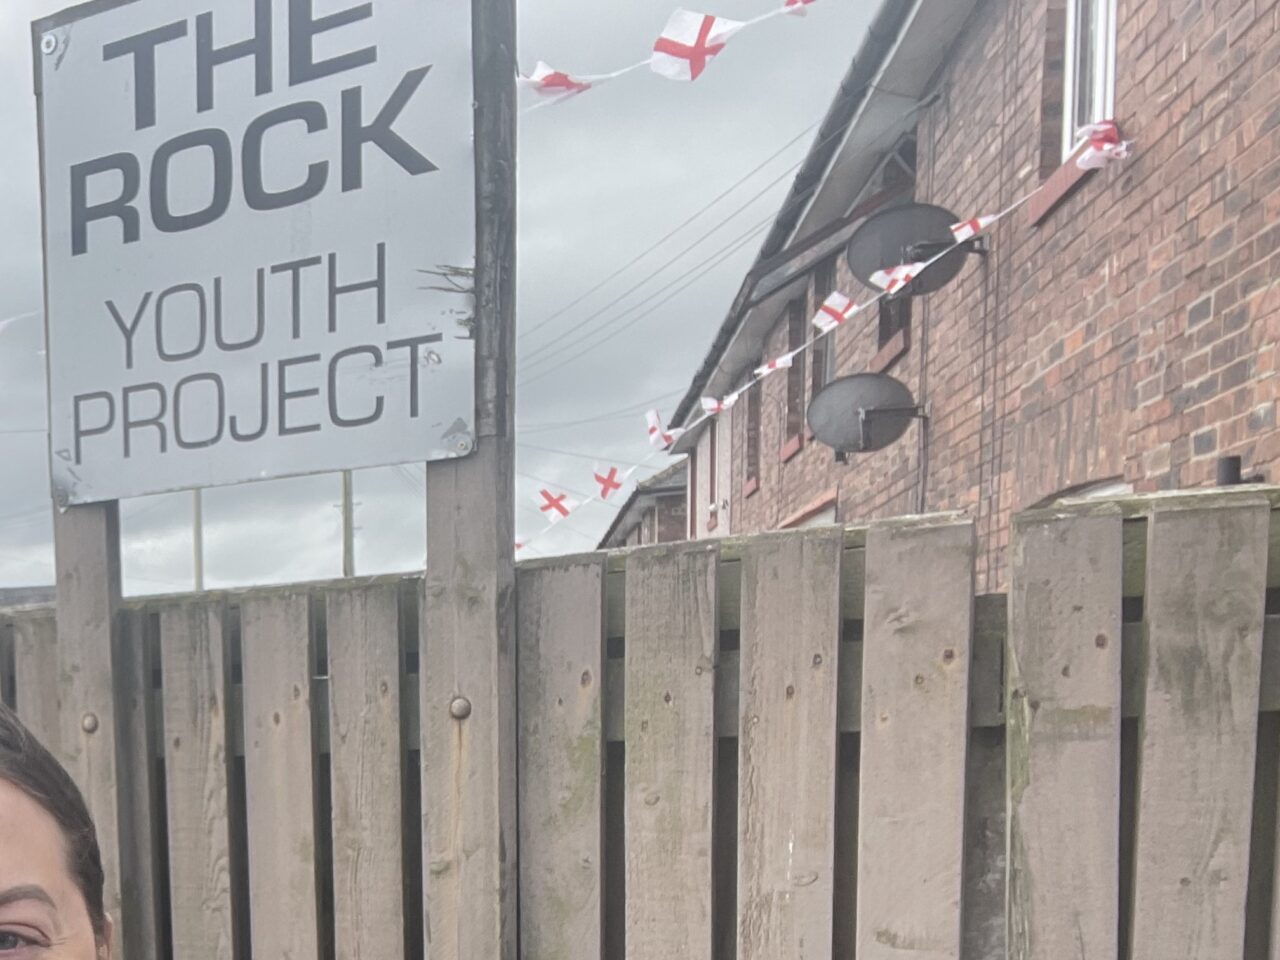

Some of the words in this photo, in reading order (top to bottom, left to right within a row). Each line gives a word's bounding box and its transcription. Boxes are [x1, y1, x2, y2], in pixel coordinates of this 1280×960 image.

[103, 0, 377, 131] THE
[70, 64, 440, 257] ROCK
[104, 242, 386, 370] YOUTH
[73, 333, 443, 466] PROJECT
